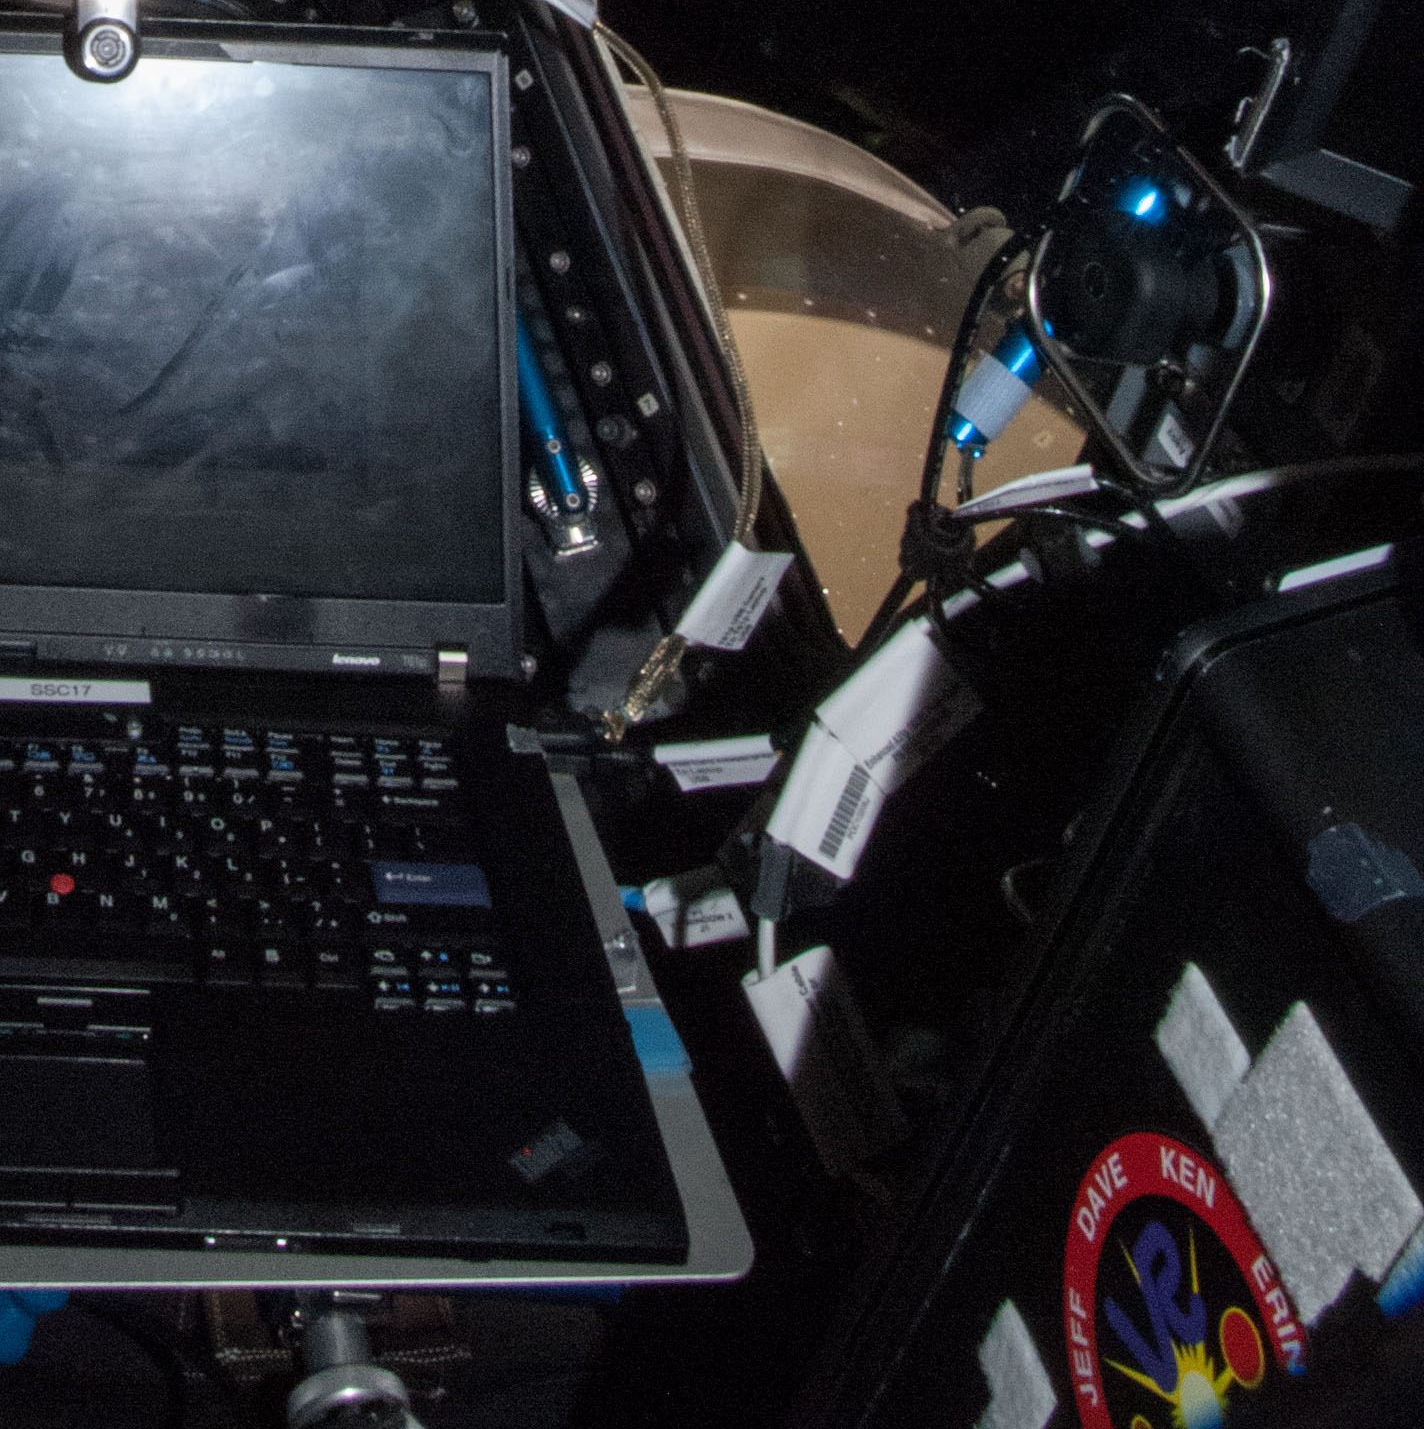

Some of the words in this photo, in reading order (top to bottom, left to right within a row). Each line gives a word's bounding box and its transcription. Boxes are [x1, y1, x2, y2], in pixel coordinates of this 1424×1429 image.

[31, 684, 92, 697] SSC17
[10, 809, 21, 822] T
[59, 811, 71, 825] Y
[109, 813, 122, 827] U
[159, 815, 165, 827] I
[210, 817, 225, 831] O
[260, 819, 273, 831] P
[21, 849, 35, 863] G
[72, 852, 85, 865] H
[125, 854, 134, 867] J
[176, 855, 188, 869] K
[227, 857, 239, 871] L
[46, 892, 60, 906] B
[100, 894, 113, 908] N
[152, 896, 168, 910] M
[1160, 1146, 1216, 1207] KEN
[1076, 1152, 1128, 1242] DAVE
[1251, 1254, 1309, 1376] ERIN
[1068, 1287, 1099, 1406] JEFF
